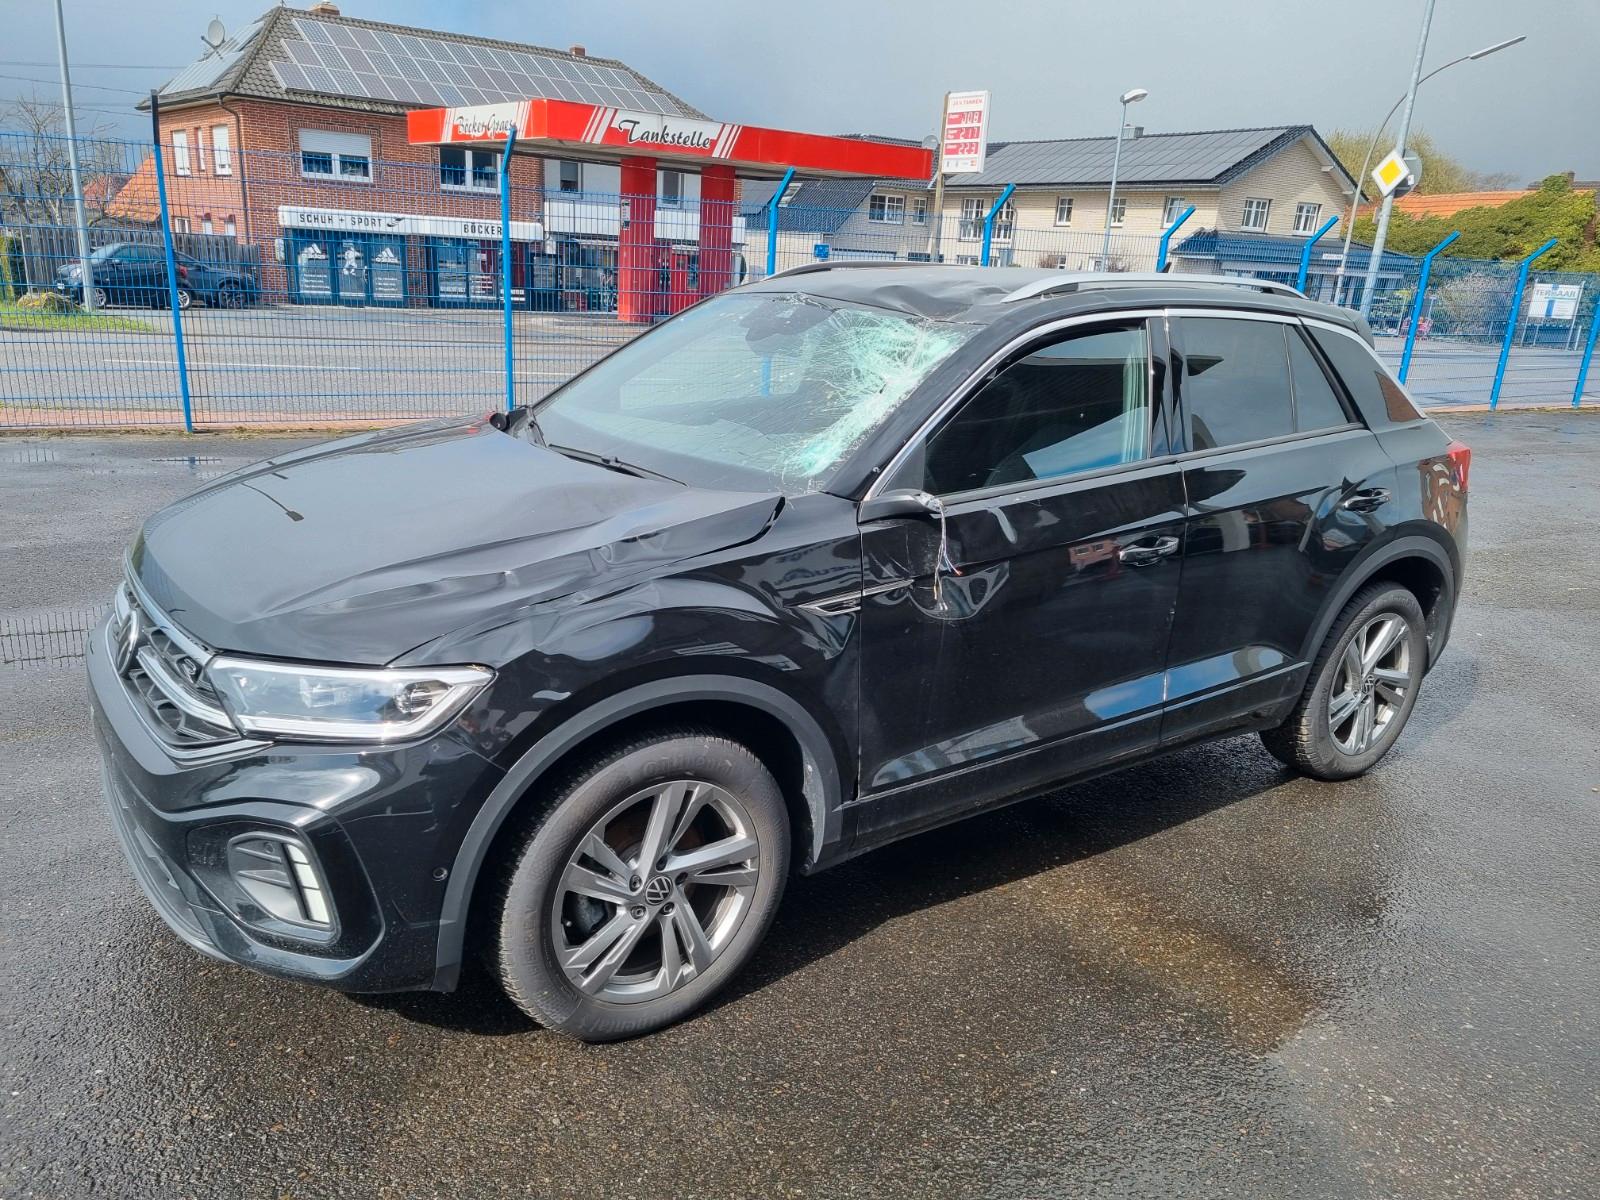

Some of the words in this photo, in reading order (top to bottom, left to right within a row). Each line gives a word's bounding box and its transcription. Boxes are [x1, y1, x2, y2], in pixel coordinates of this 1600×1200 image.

[618, 119, 711, 148] Tankstelle
[299, 213, 334, 224] SCHUH
[351, 216, 382, 227] SPORT
[463, 222, 502, 235] BÖCKER
